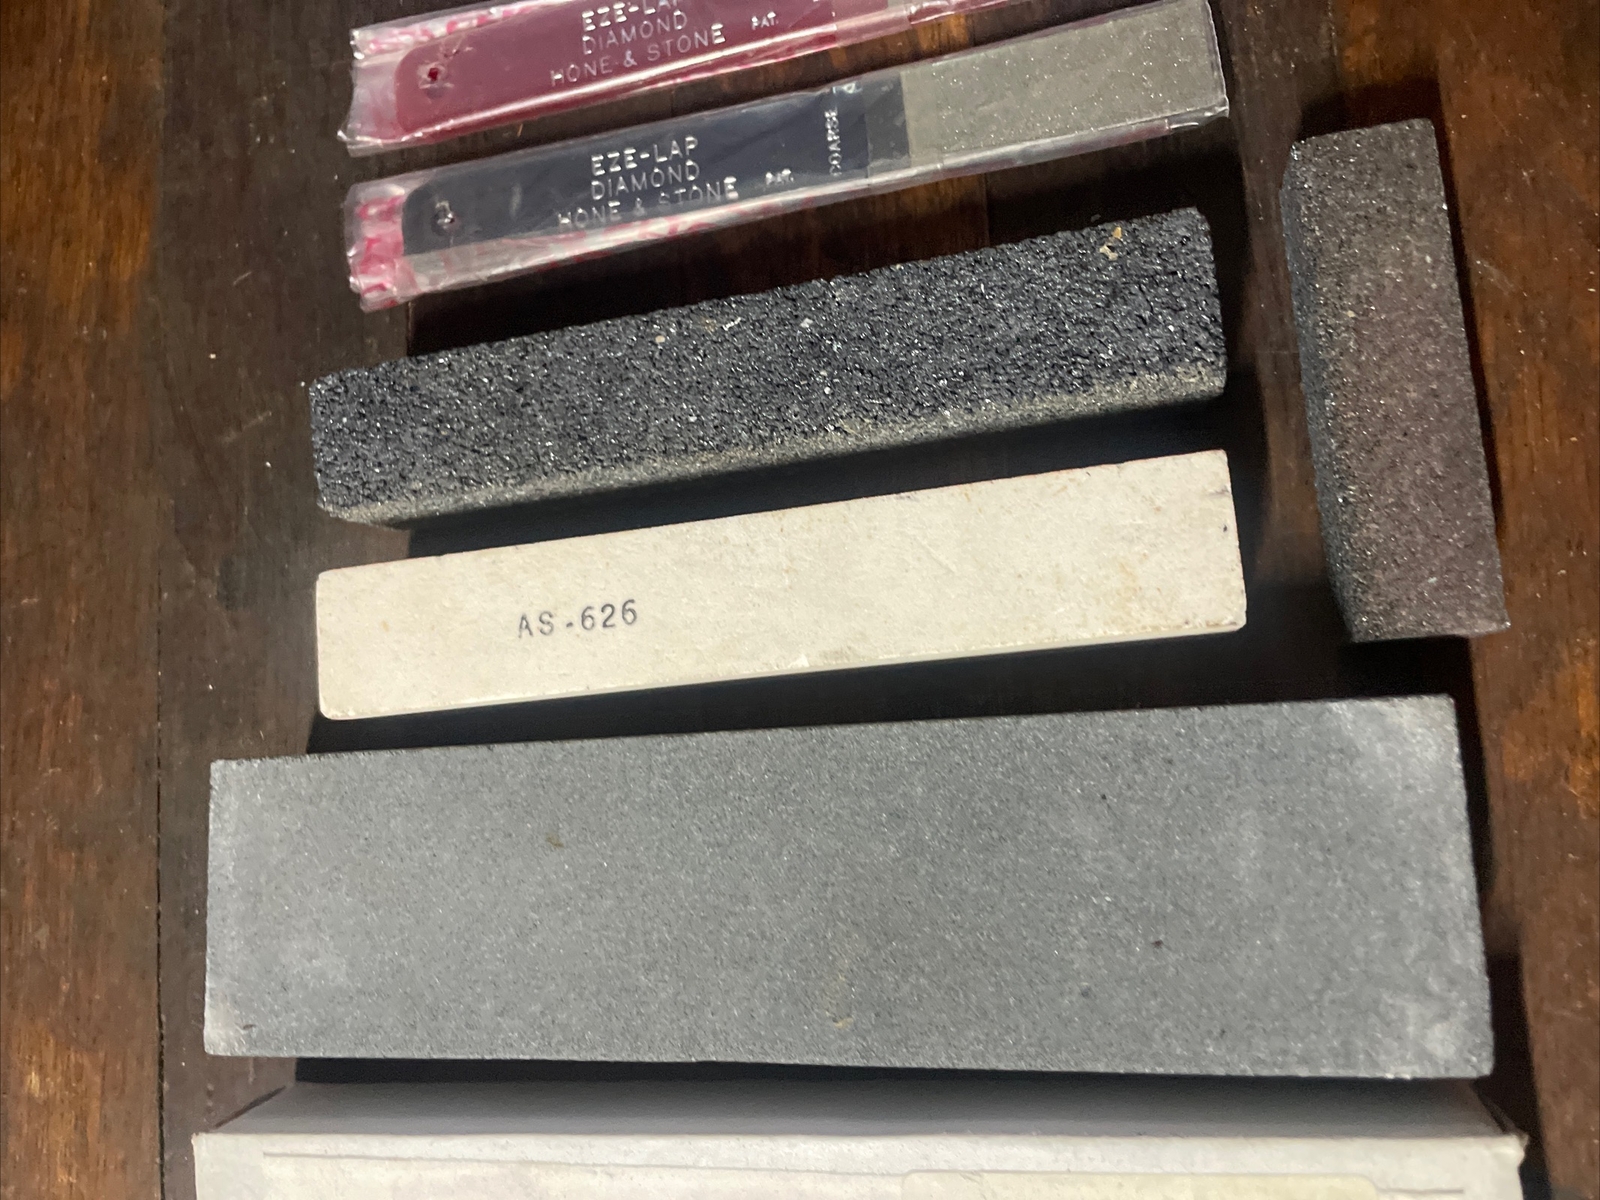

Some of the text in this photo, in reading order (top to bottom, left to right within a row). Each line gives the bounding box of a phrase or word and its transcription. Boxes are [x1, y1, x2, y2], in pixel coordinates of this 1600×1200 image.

[550, 23, 726, 86] HONE & STONE
[582, 9, 688, 53] DIAMOND
[591, 136, 699, 176] EZE-LAP
[824, 107, 842, 176] COARSE
[558, 200, 622, 232] HONE
[658, 176, 739, 206] STONE
[591, 159, 699, 200] DIAMOND
